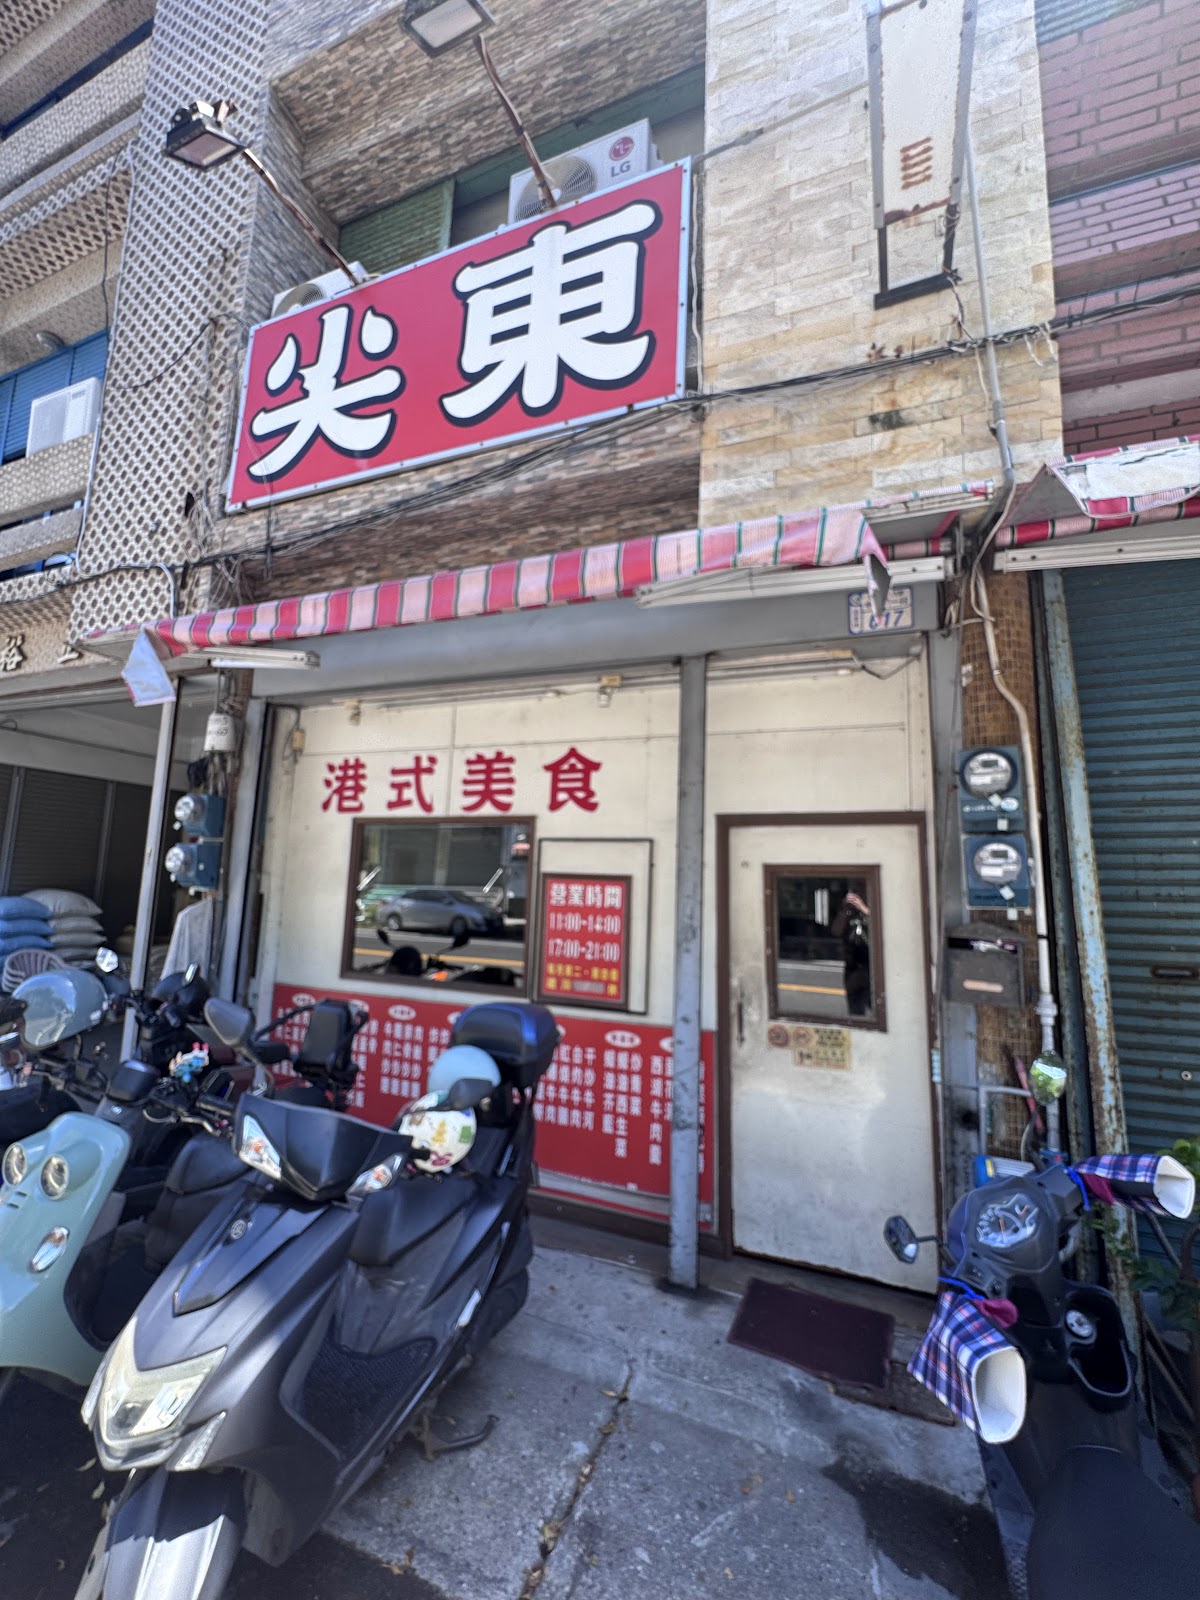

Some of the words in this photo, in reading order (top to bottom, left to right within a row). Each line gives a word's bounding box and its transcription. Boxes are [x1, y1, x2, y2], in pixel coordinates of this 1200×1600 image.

[611, 161, 631, 177] LG
[246, 200, 661, 486] 尖東
[322, 747, 602, 813] 港式美食
[550, 883, 623, 910] 營業時間
